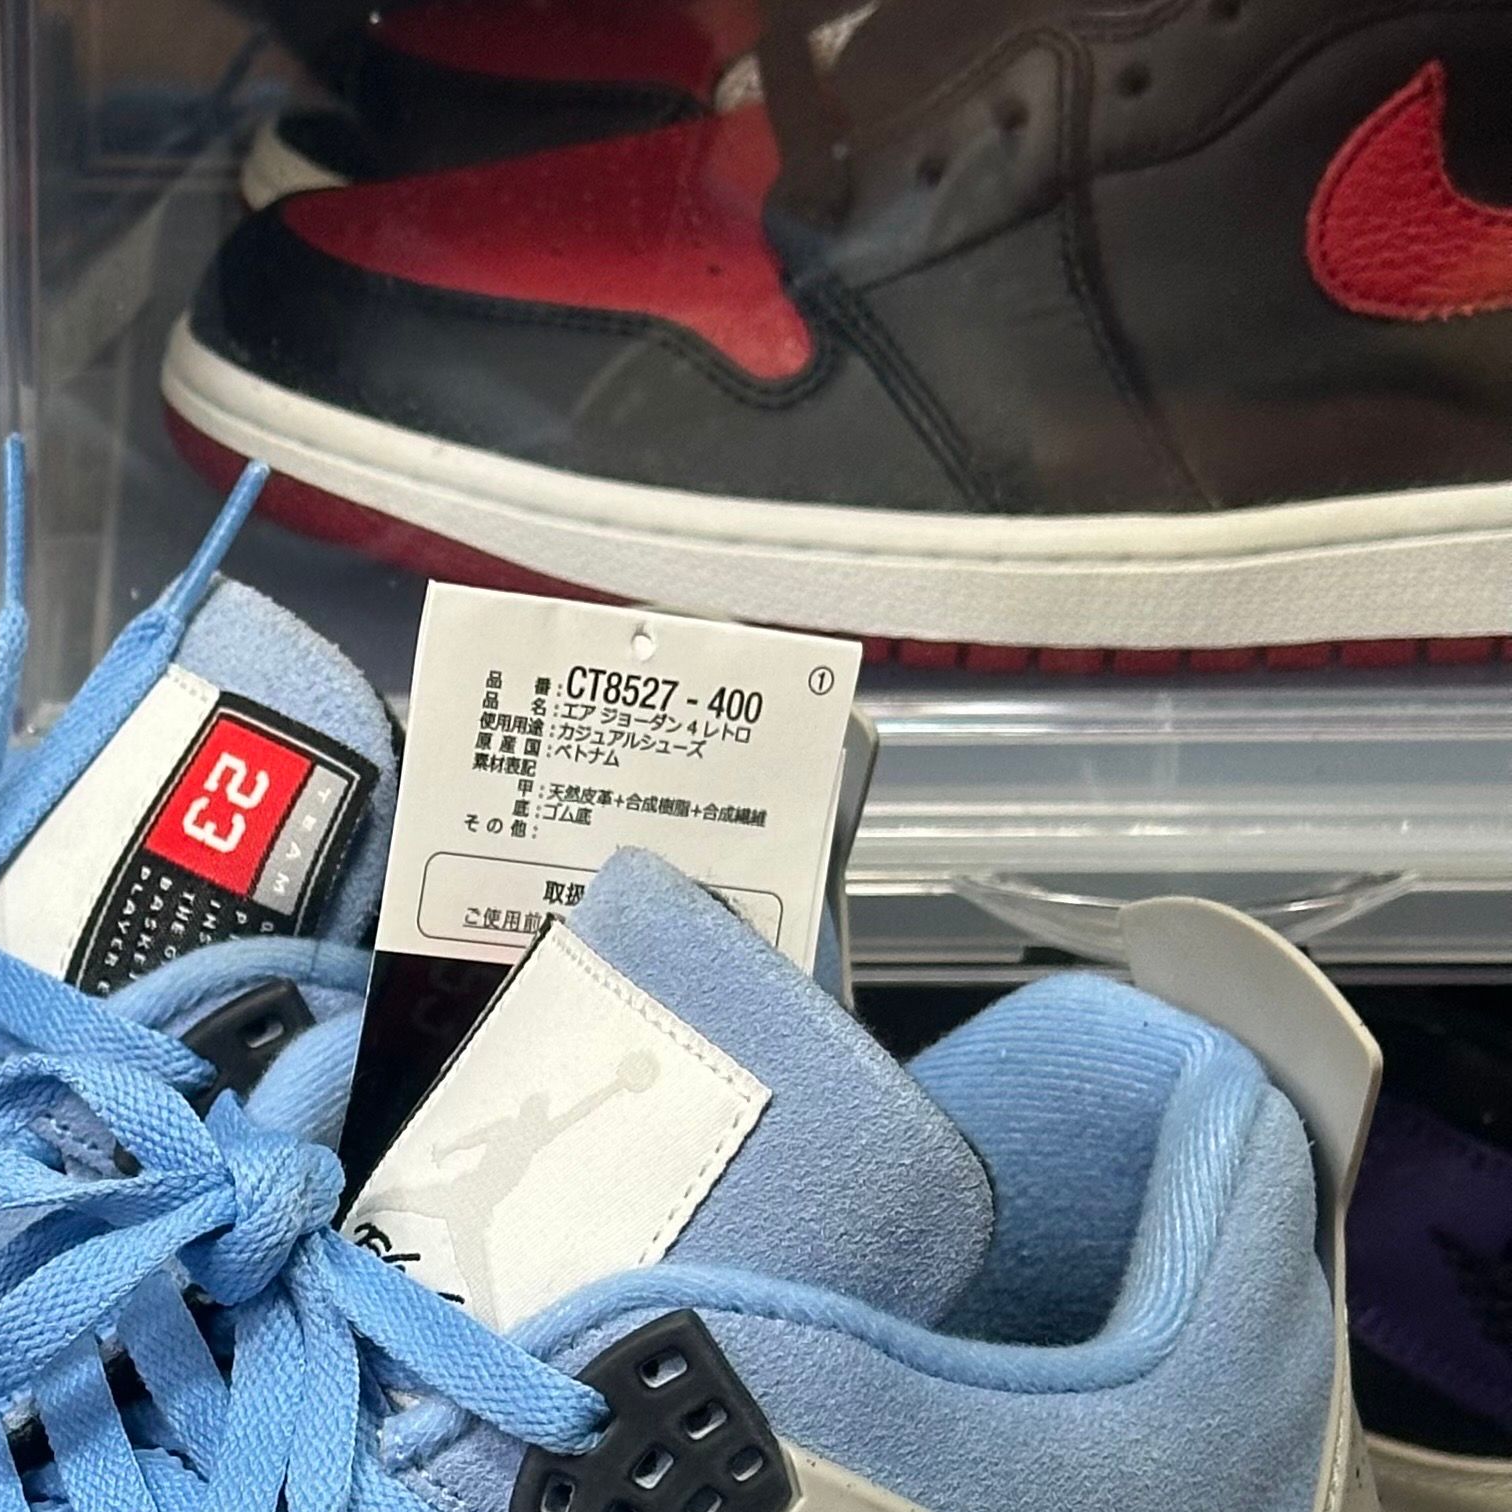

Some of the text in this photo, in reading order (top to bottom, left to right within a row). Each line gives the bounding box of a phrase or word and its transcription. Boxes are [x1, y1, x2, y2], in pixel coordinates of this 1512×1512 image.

[182, 751, 270, 854] 23
[273, 787, 332, 894] TEAM
[104, 865, 152, 967] PLAYER
[171, 890, 195, 936] THE
